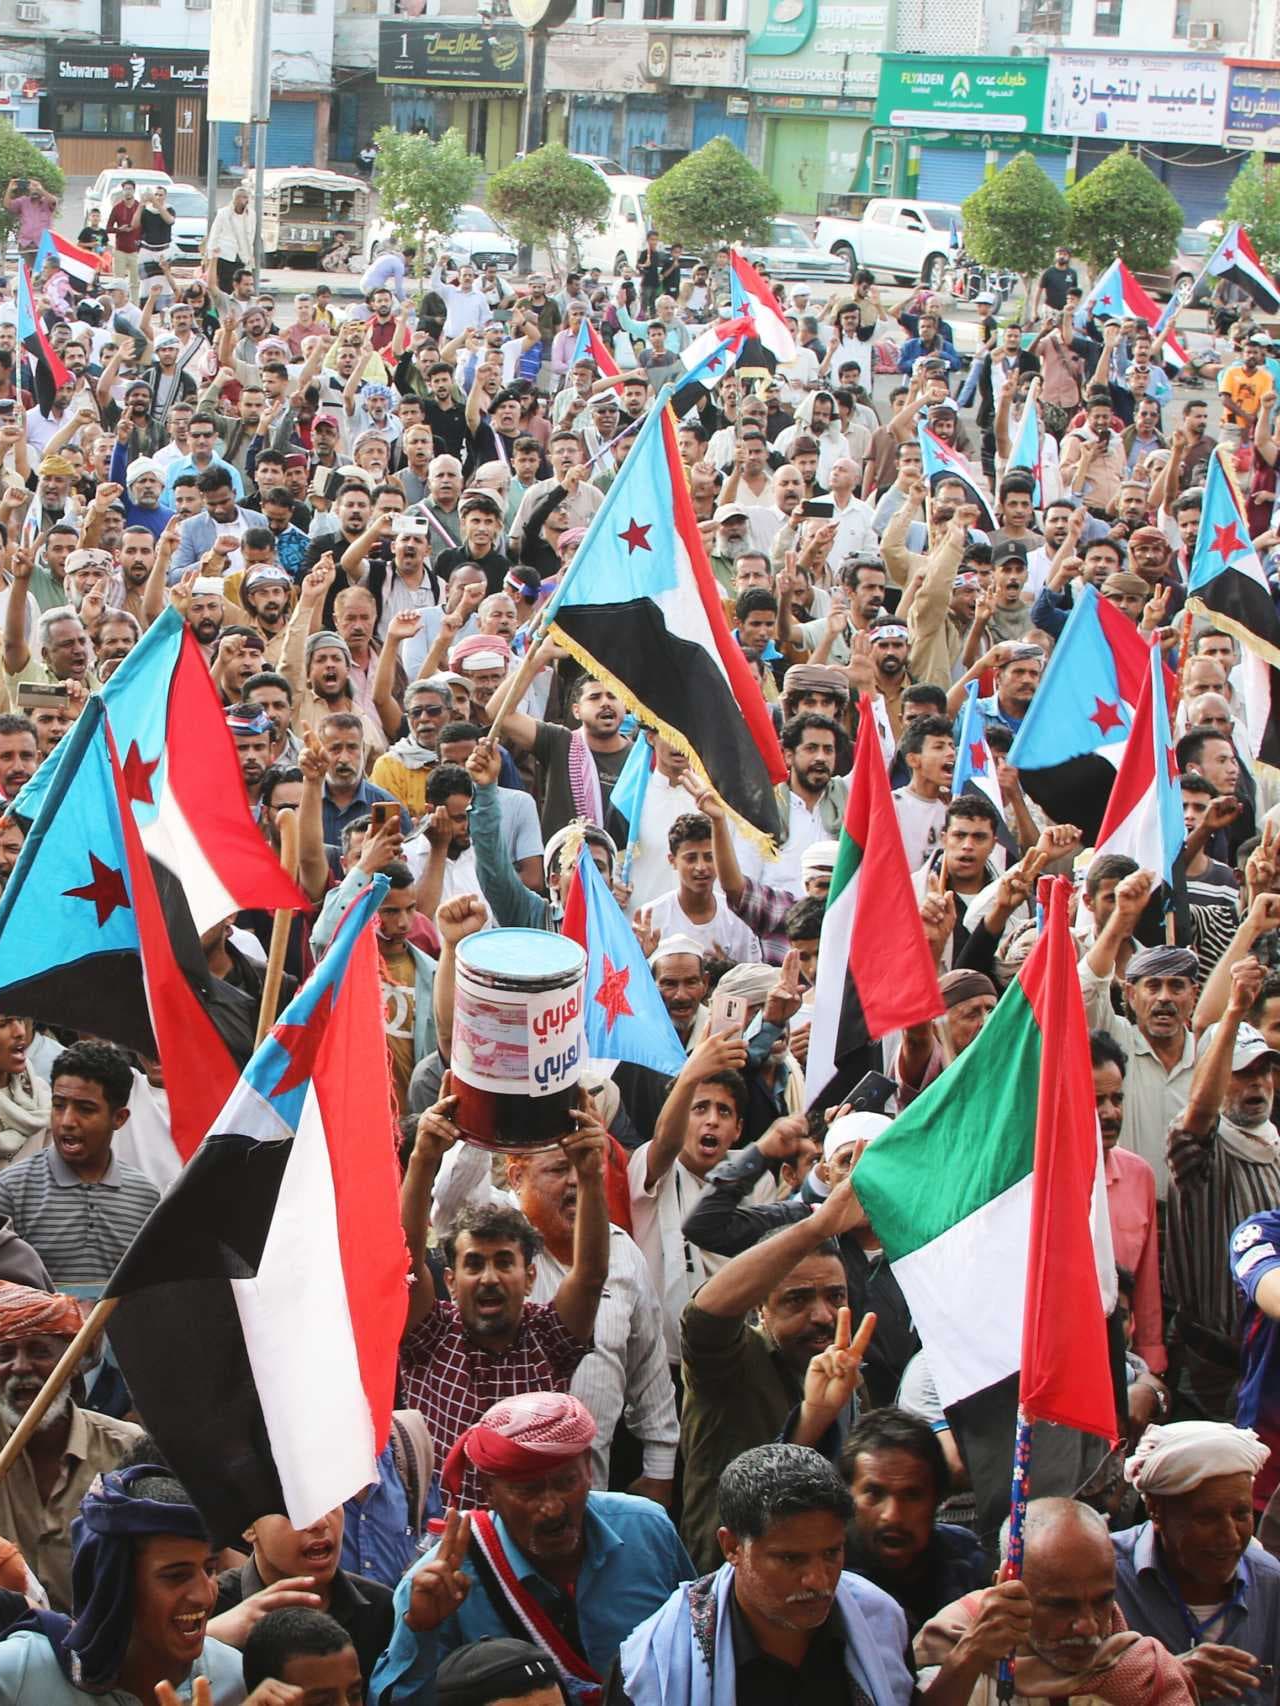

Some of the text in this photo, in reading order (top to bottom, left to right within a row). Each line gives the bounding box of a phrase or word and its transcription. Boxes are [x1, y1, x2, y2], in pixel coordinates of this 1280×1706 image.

[399, 33, 409, 58] 1
[59, 61, 108, 80] Shawarma
[752, 68, 768, 80] BIN
[771, 68, 803, 80] YAZEED
[804, 69, 824, 81] FOR
[901, 72, 944, 85] FLYADEN
[1071, 76, 1217, 115] باعبيد للتجارة
[532, 985, 582, 1046] العربي
[533, 1031, 582, 1092] العربي
